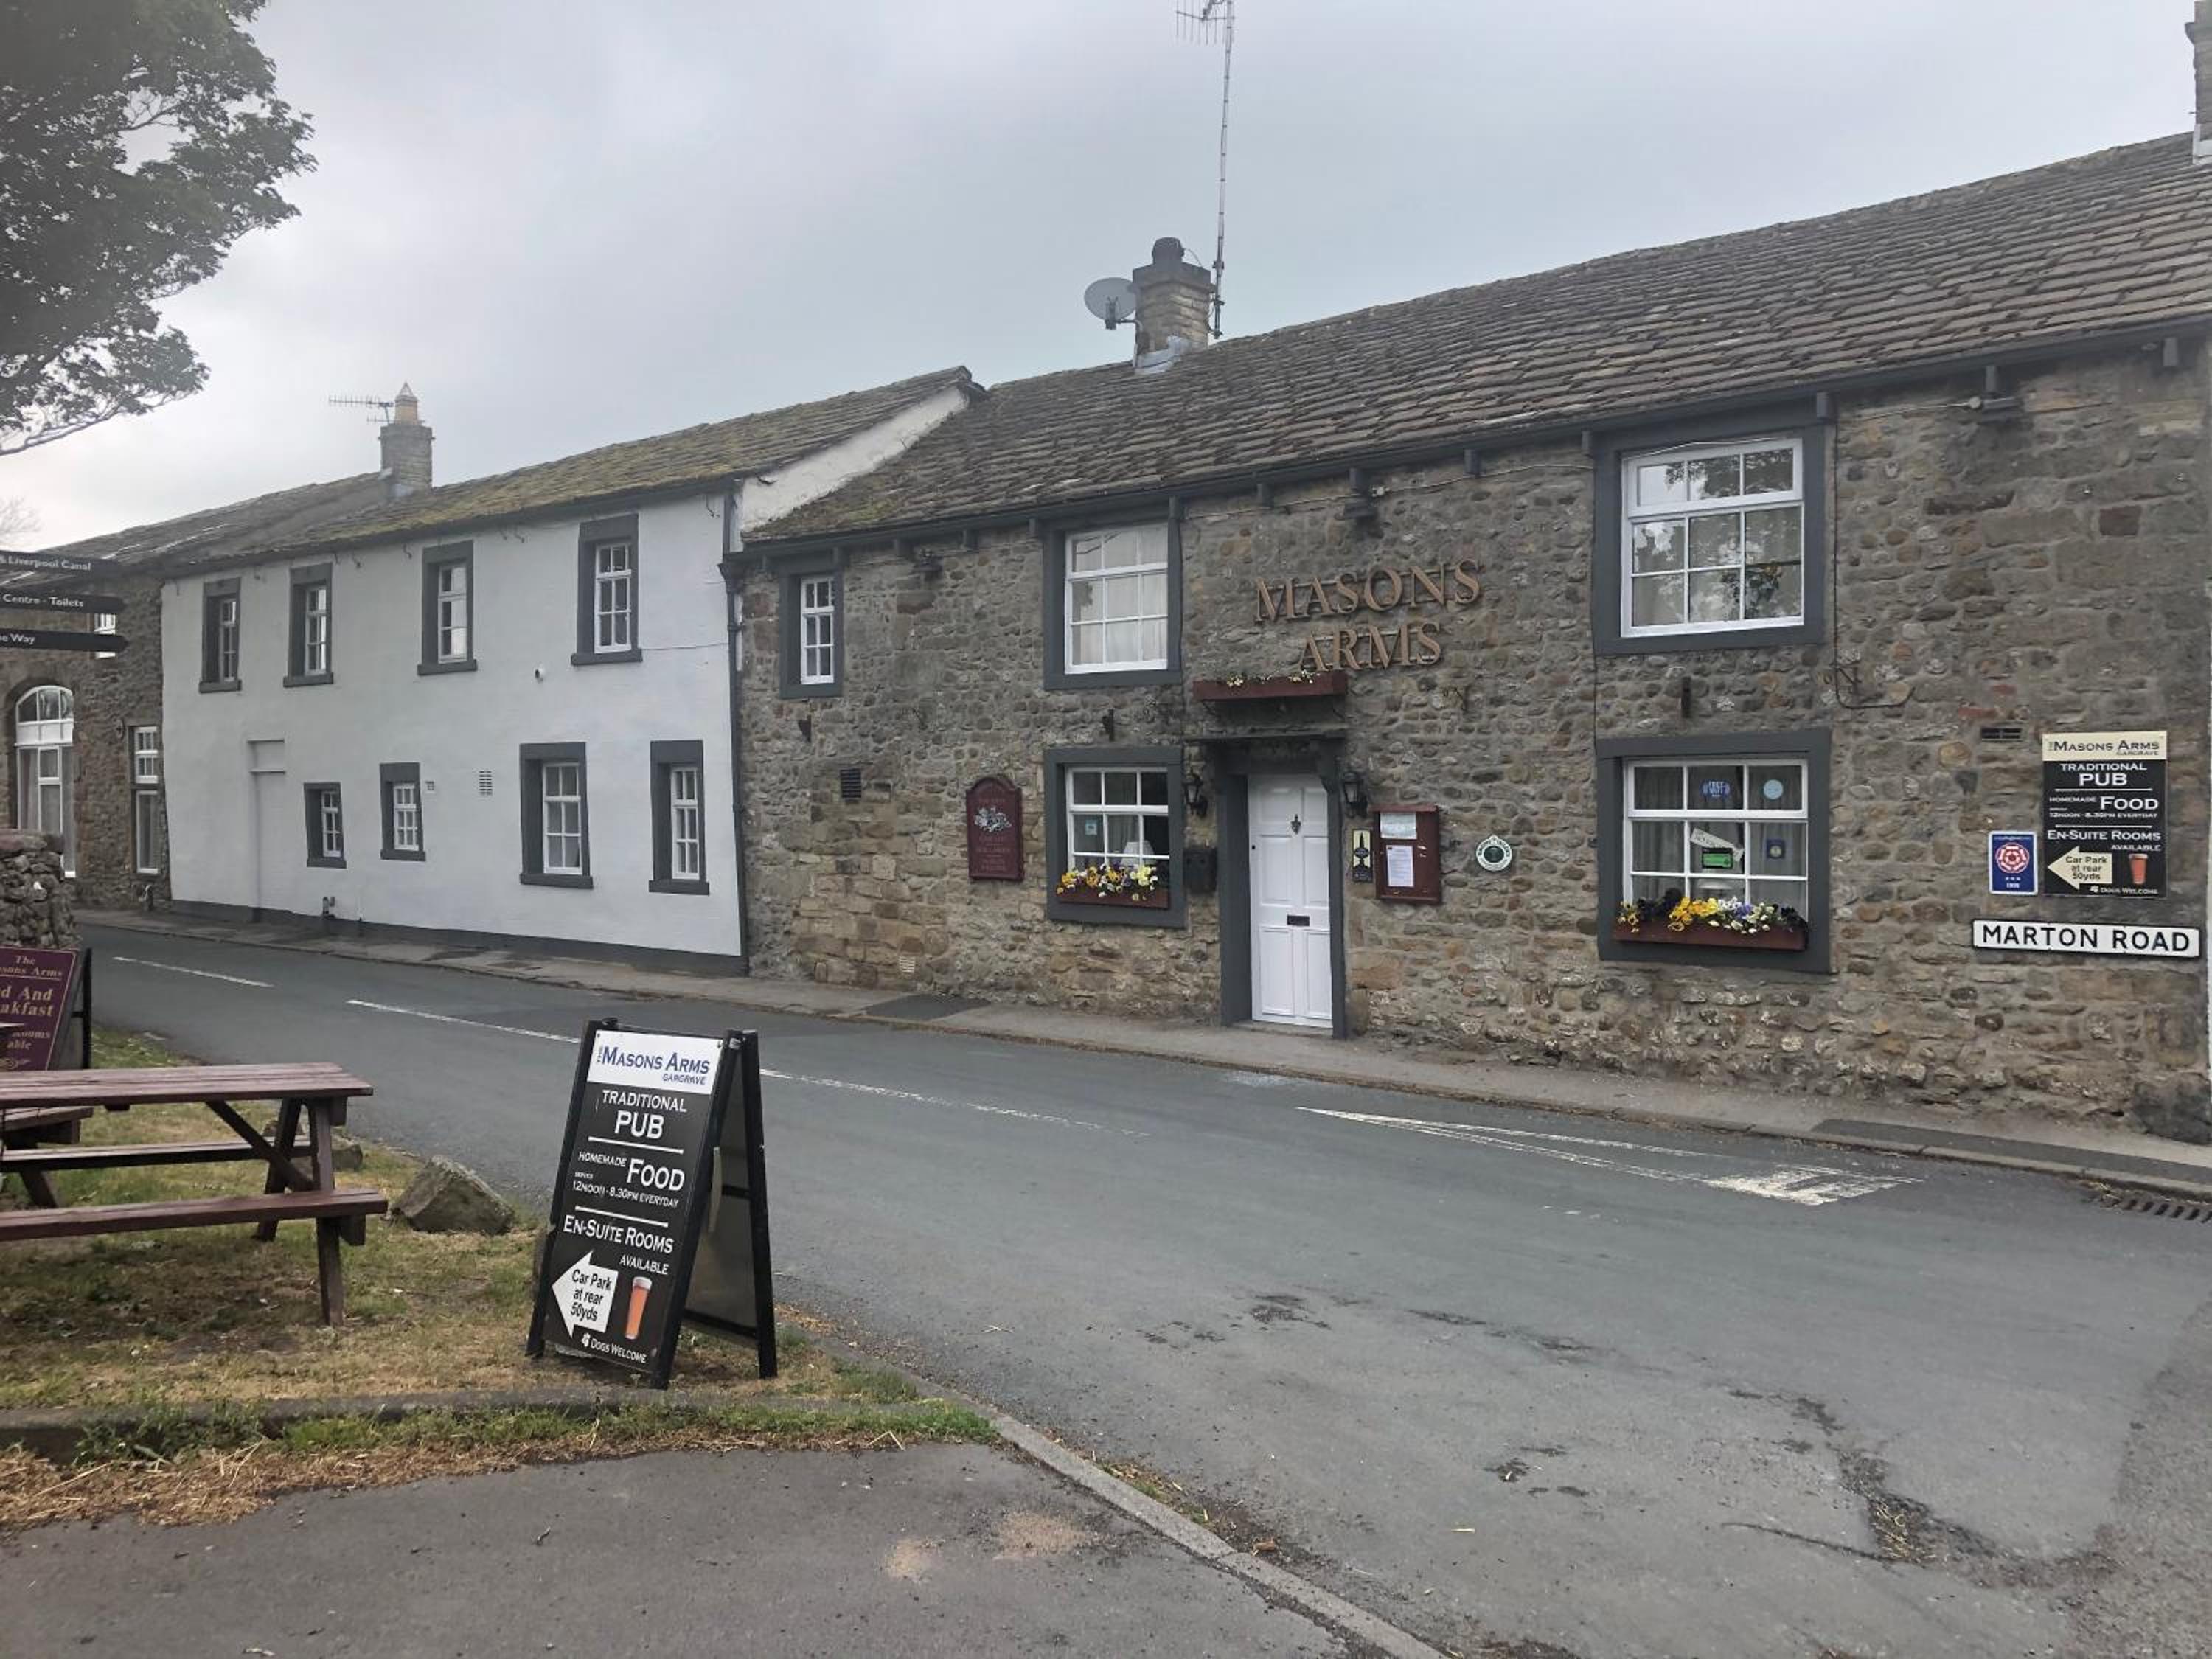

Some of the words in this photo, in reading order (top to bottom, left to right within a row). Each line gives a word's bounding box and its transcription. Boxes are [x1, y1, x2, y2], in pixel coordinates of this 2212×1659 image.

[8, 556, 59, 568] Liverpool
[61, 560, 91, 571] Canal
[1255, 559, 1480, 622] MASONS
[3, 594, 40, 604] Centre
[48, 597, 83, 607] Toilets
[10, 633, 35, 645] Way
[1299, 622, 1441, 671] ARMS
[2053, 741, 2114, 751] MASONS
[2117, 740, 2160, 750] ARMS
[2060, 763, 2147, 771] TRADITIONAL
[2079, 773, 2127, 787] PUB
[2100, 796, 2159, 810] FOOD
[2048, 830, 2108, 840] EN-SUITE
[2111, 830, 2161, 841] ROOMS
[1983, 925, 2098, 947] MARTON
[2112, 930, 2190, 952] ROAD
[15, 956, 36, 965] The
[32, 967, 63, 976] Arms
[18, 986, 53, 1001] And
[602, 1046, 663, 1069] MASONS
[667, 1052, 710, 1074] ARMS
[662, 1073, 707, 1086] GARGRAVE
[602, 1090, 687, 1113] TRADITIONAL
[614, 1110, 664, 1139] PUB
[578, 1152, 627, 1167] HOMEMADE
[627, 1158, 685, 1191] FOOD
[573, 1180, 605, 1198] 12NOON
[609, 1186, 639, 1202] 8.30PM
[639, 1192, 679, 1208] EVERYDAY
[563, 1214, 625, 1243] EN-SUITE
[625, 1226, 675, 1253] ROOMS
[619, 1254, 669, 1275] AVAILABLE
[571, 1269, 589, 1285] Car
[591, 1273, 612, 1290] Park
[574, 1288, 583, 1301] at
[584, 1292, 603, 1305] rear
[571, 1302, 598, 1322] 50yds
[591, 1339, 610, 1353] DOGS
[611, 1343, 647, 1363] WELCOME
